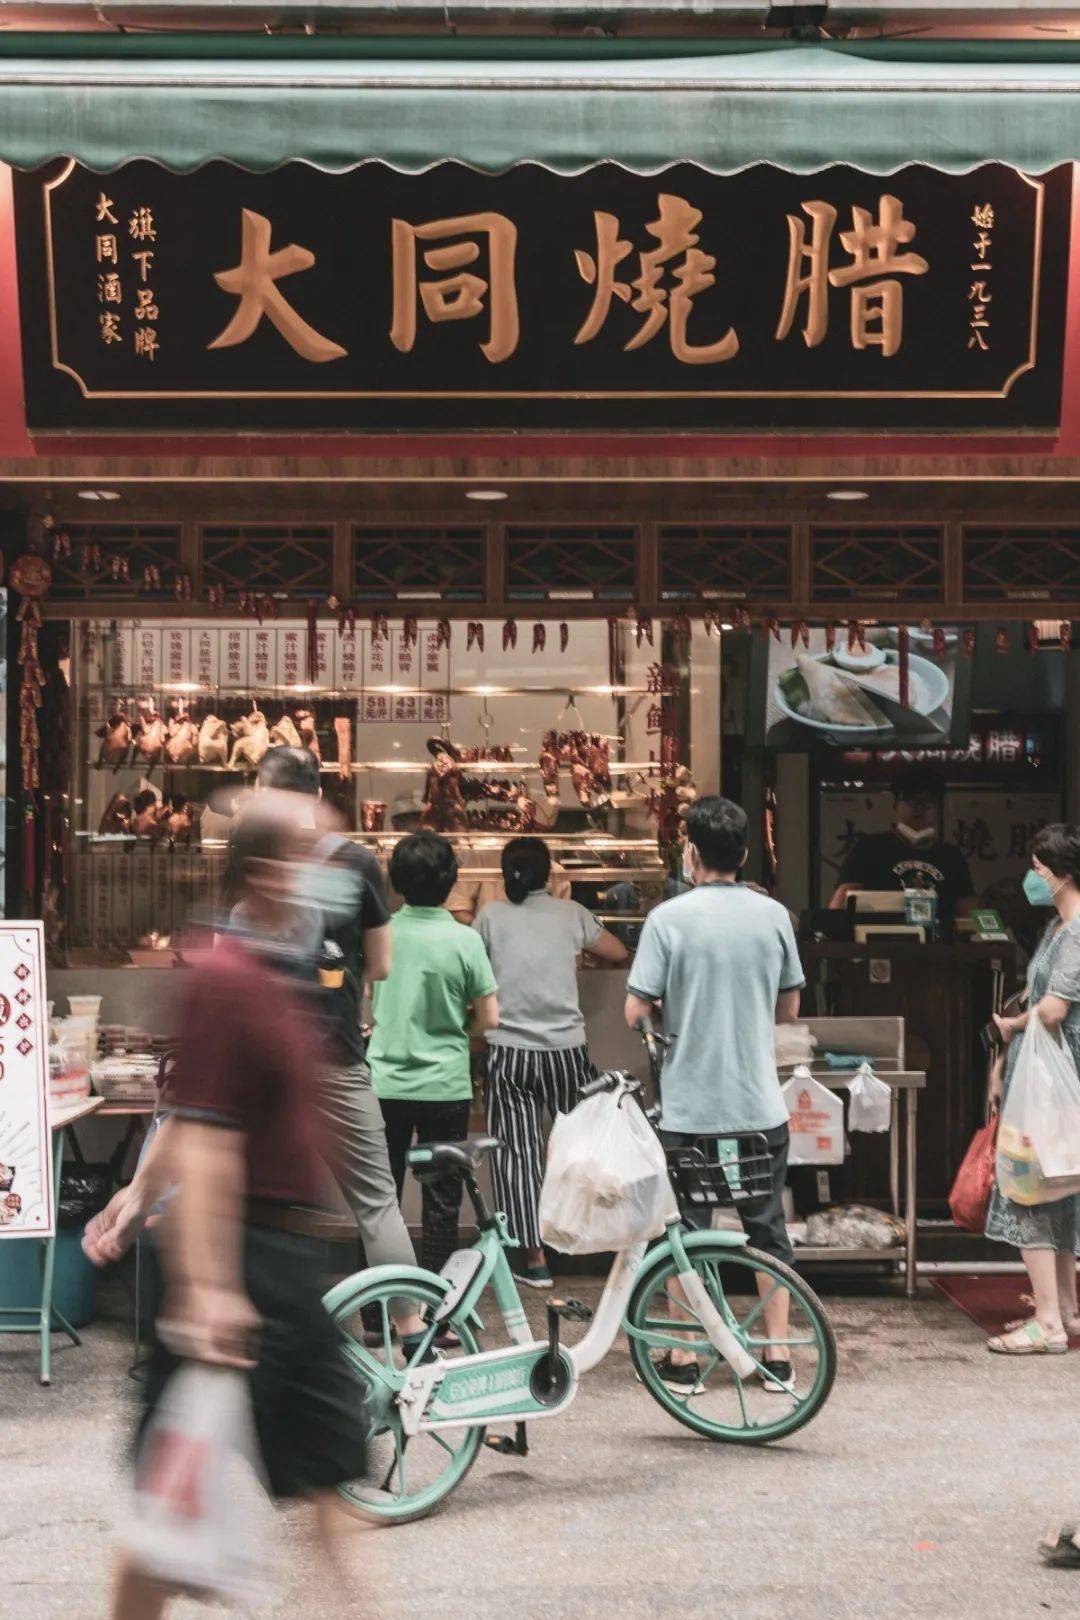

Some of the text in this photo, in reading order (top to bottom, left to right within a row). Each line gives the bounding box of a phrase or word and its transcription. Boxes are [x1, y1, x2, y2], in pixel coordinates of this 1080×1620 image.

[94, 191, 123, 346] 大同酒家
[127, 205, 161, 362] 旗下品牌
[206, 192, 930, 366] 大同燒腊
